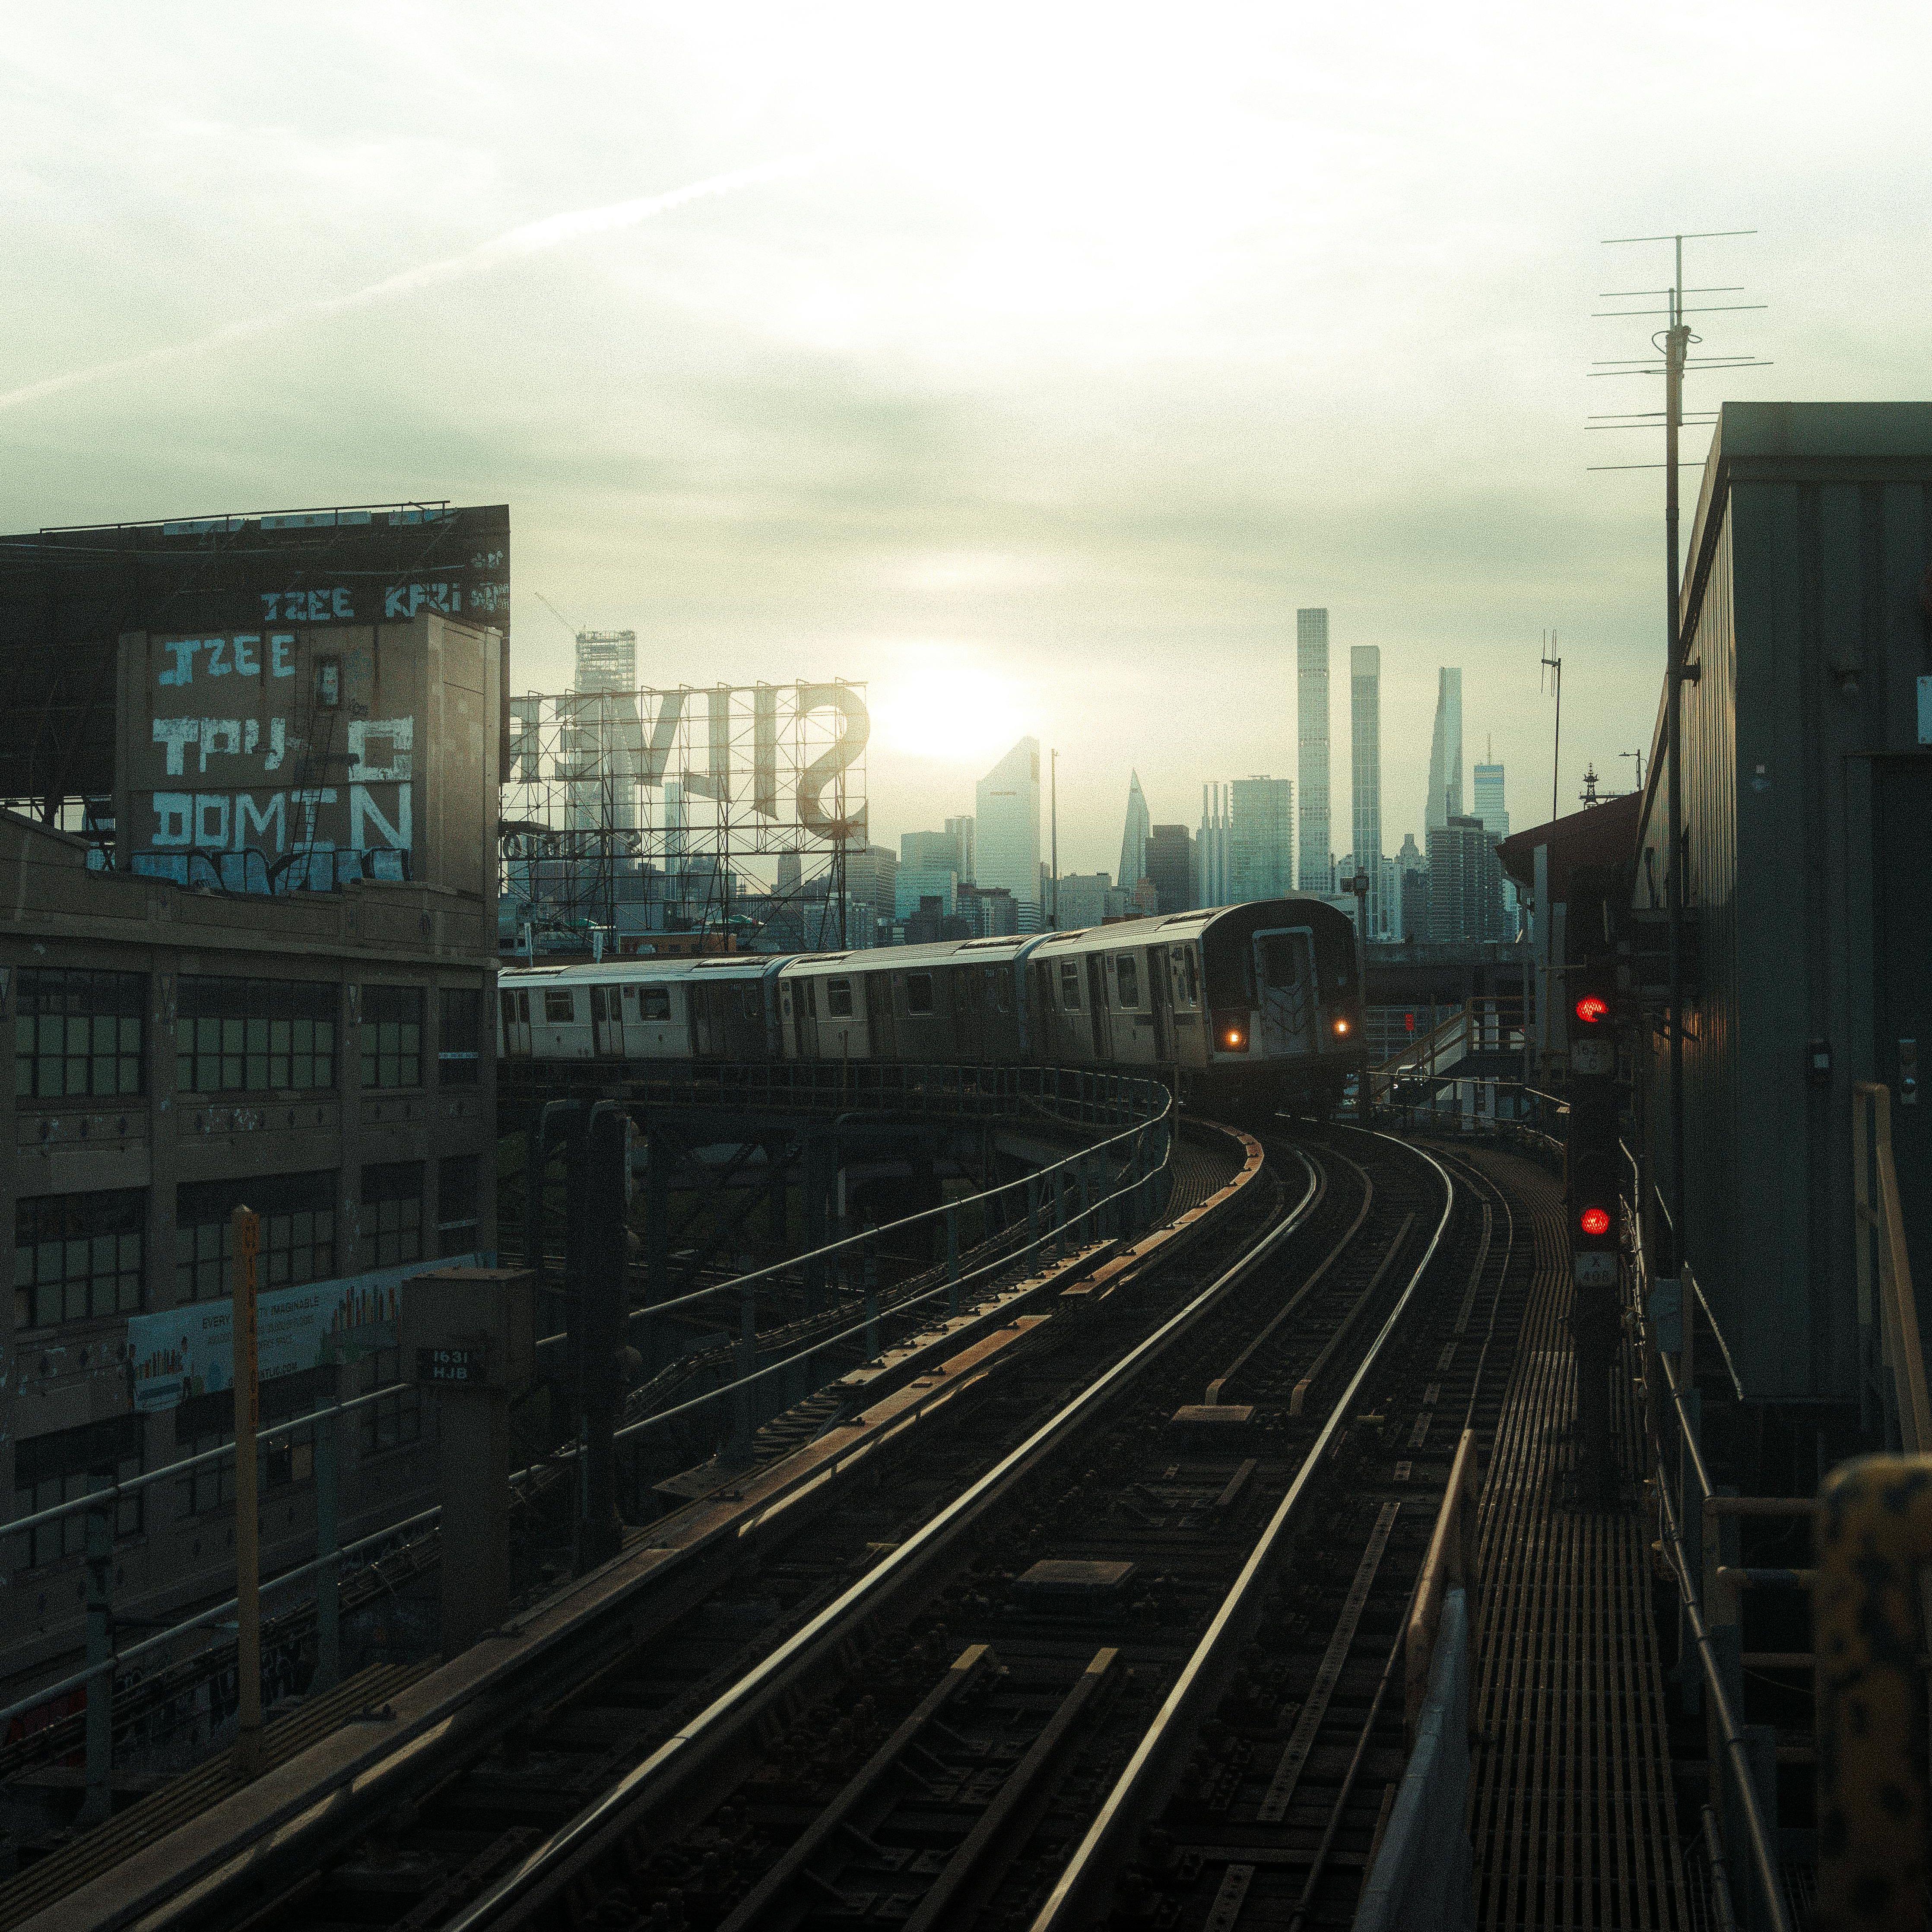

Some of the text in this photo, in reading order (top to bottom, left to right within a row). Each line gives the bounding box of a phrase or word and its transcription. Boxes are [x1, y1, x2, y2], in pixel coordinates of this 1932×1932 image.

[202, 1314, 231, 1329] EVERY
[433, 1350, 469, 1364] 1631
[433, 1366, 468, 1380] HJB
